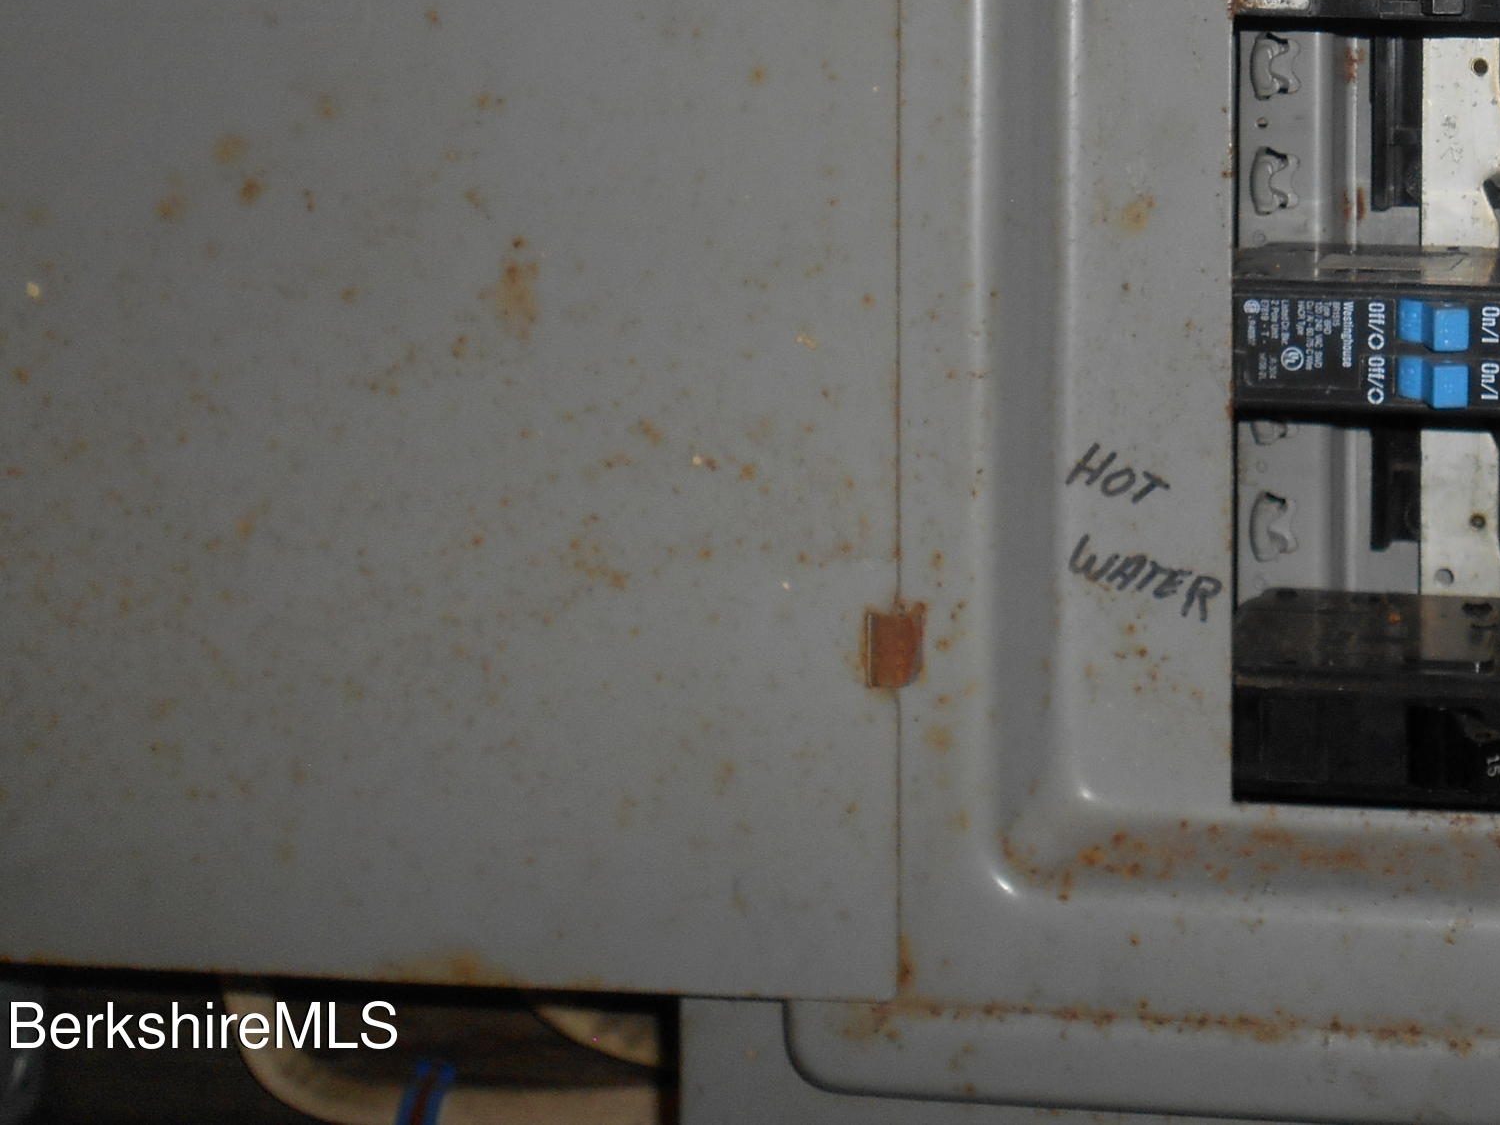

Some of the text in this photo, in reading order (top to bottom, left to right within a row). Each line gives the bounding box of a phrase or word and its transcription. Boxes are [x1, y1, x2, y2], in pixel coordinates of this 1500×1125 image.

[1341, 301, 1354, 368] Westinghouse
[1066, 443, 1171, 505] HOT
[1068, 534, 1225, 623] WATER
[1485, 754, 1500, 779] 15
